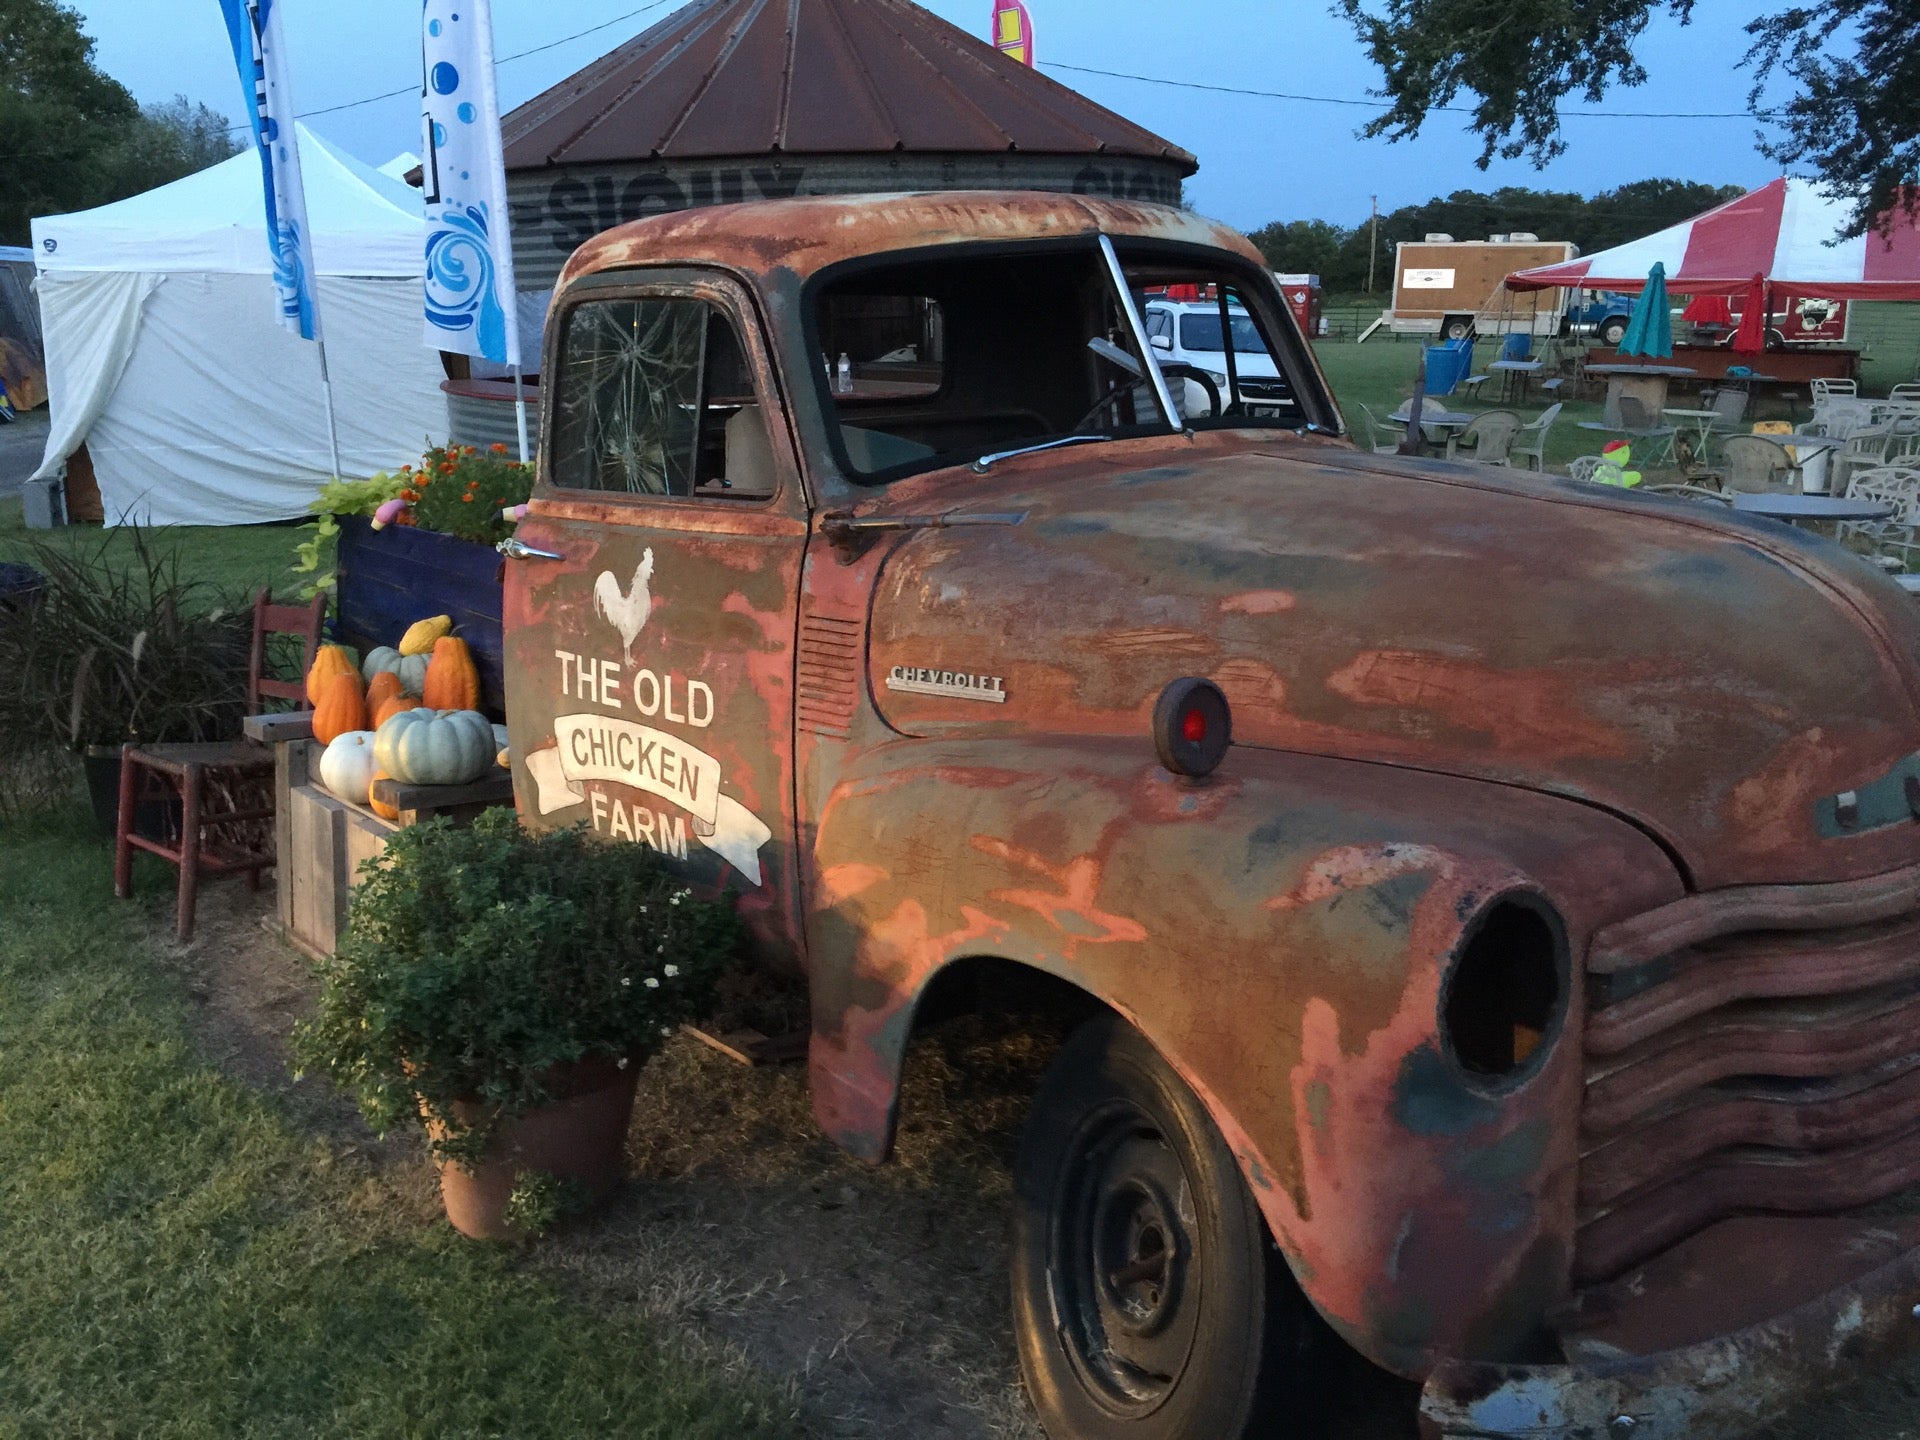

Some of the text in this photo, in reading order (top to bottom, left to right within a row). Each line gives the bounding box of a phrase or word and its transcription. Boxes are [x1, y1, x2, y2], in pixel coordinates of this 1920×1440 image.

[554, 649, 715, 728] THE OLD
[889, 665, 1004, 692] CHEVROLET
[570, 727, 700, 802] CHICKEN
[589, 790, 688, 861] FARM
